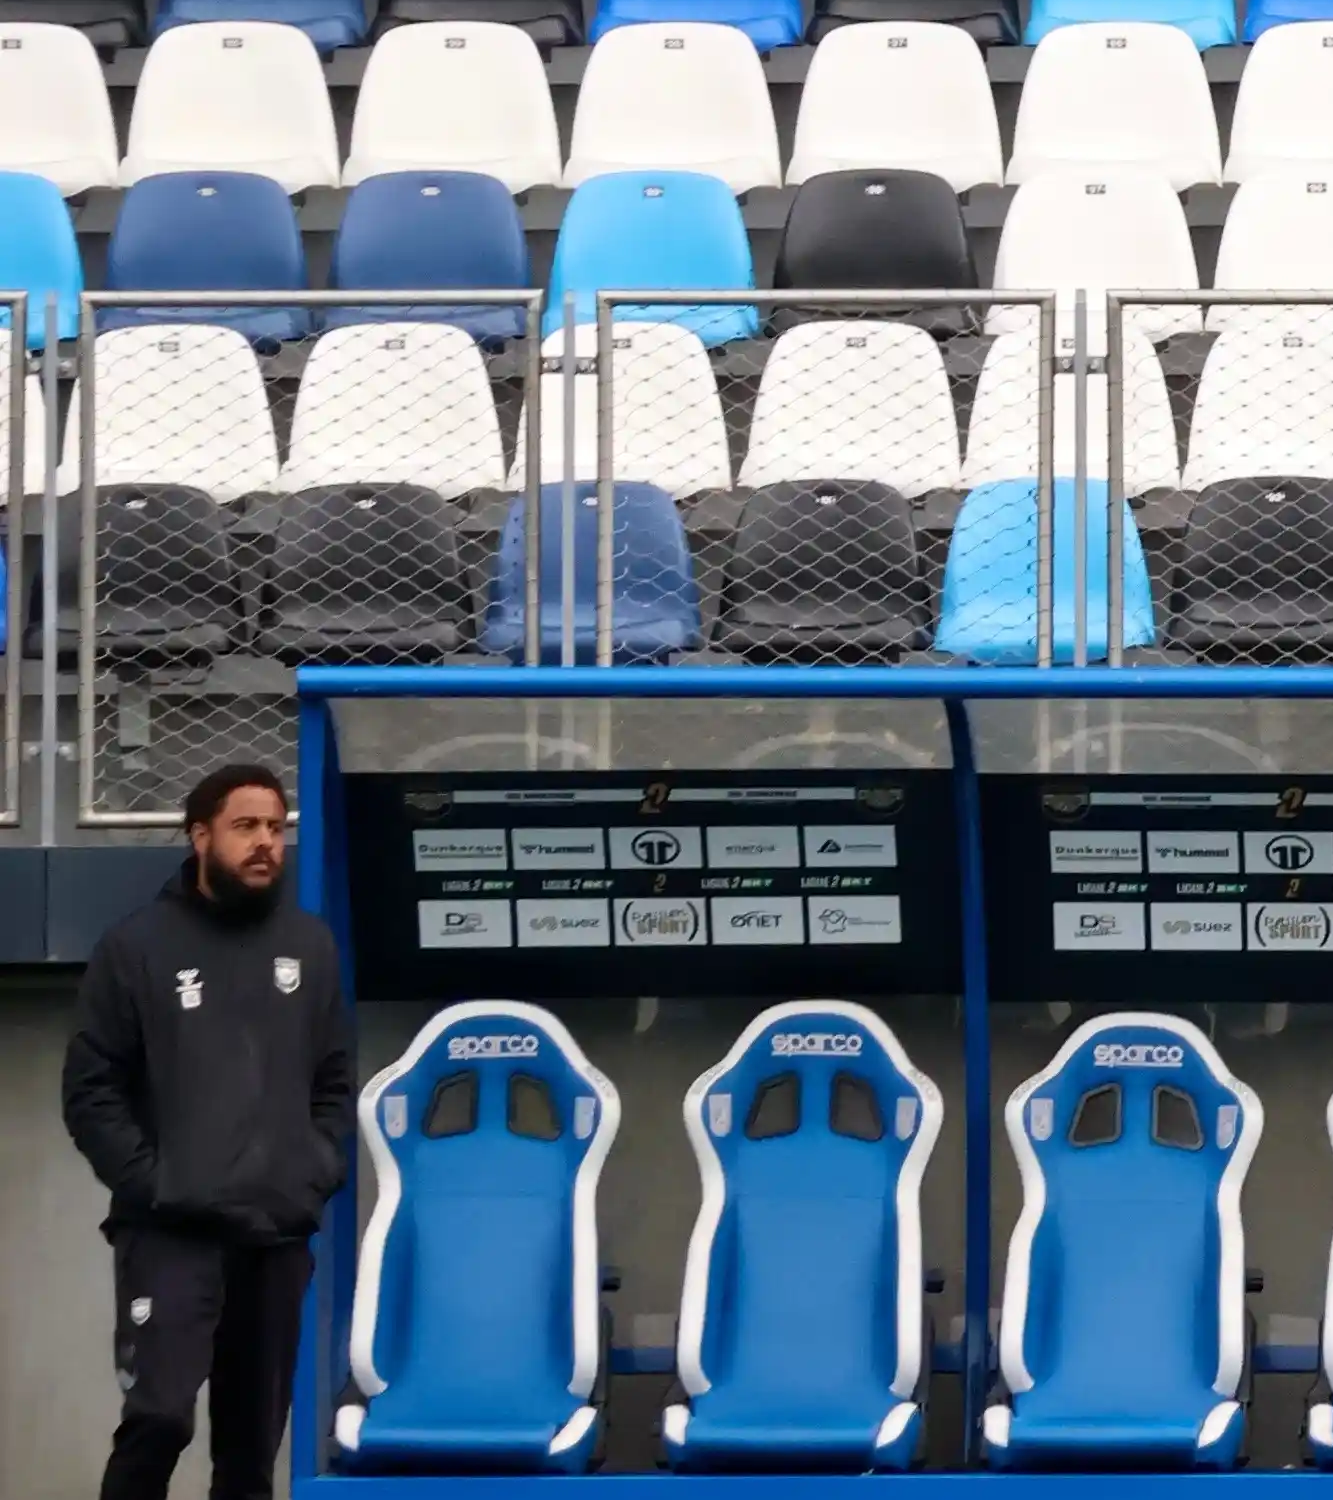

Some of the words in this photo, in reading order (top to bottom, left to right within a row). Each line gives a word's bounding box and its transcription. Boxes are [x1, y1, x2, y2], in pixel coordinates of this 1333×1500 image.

[1173, 847, 1230, 858] hummel
[448, 1034, 538, 1059] sparco
[771, 1033, 862, 1058] sparco
[1094, 1043, 1184, 1068] sparco
